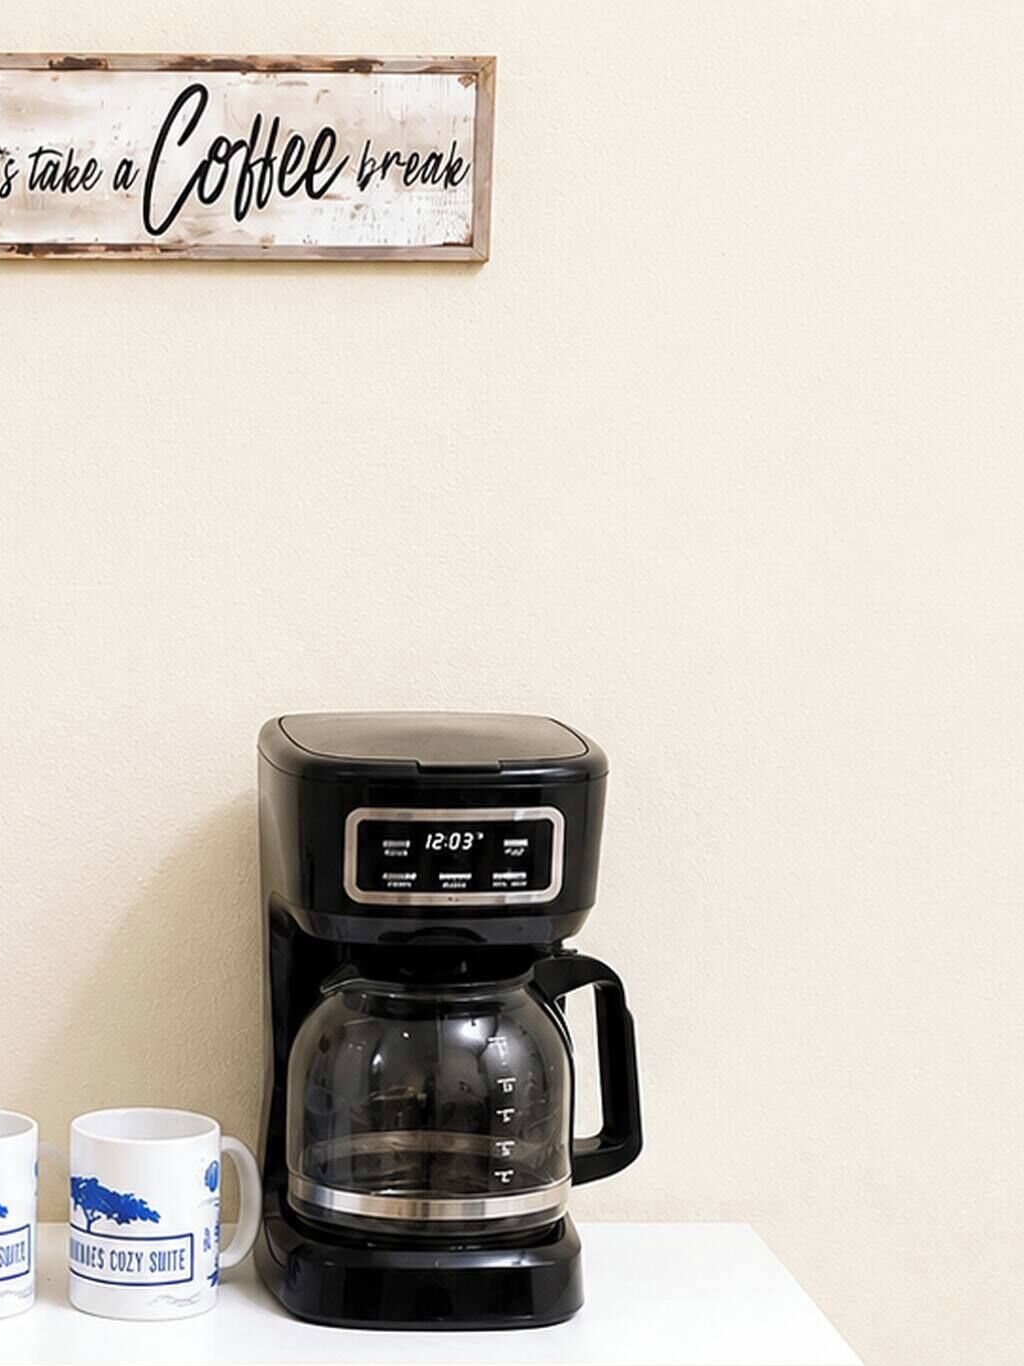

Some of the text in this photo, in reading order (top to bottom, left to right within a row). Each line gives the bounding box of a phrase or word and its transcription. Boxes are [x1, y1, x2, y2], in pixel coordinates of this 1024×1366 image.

[27, 146, 104, 194] take
[112, 156, 141, 191] a
[142, 83, 351, 237] Coffee
[356, 139, 473, 192] break
[425, 831, 475, 851] 12:03
[109, 1248, 144, 1274] COZY
[148, 1247, 187, 1274] SUITE
